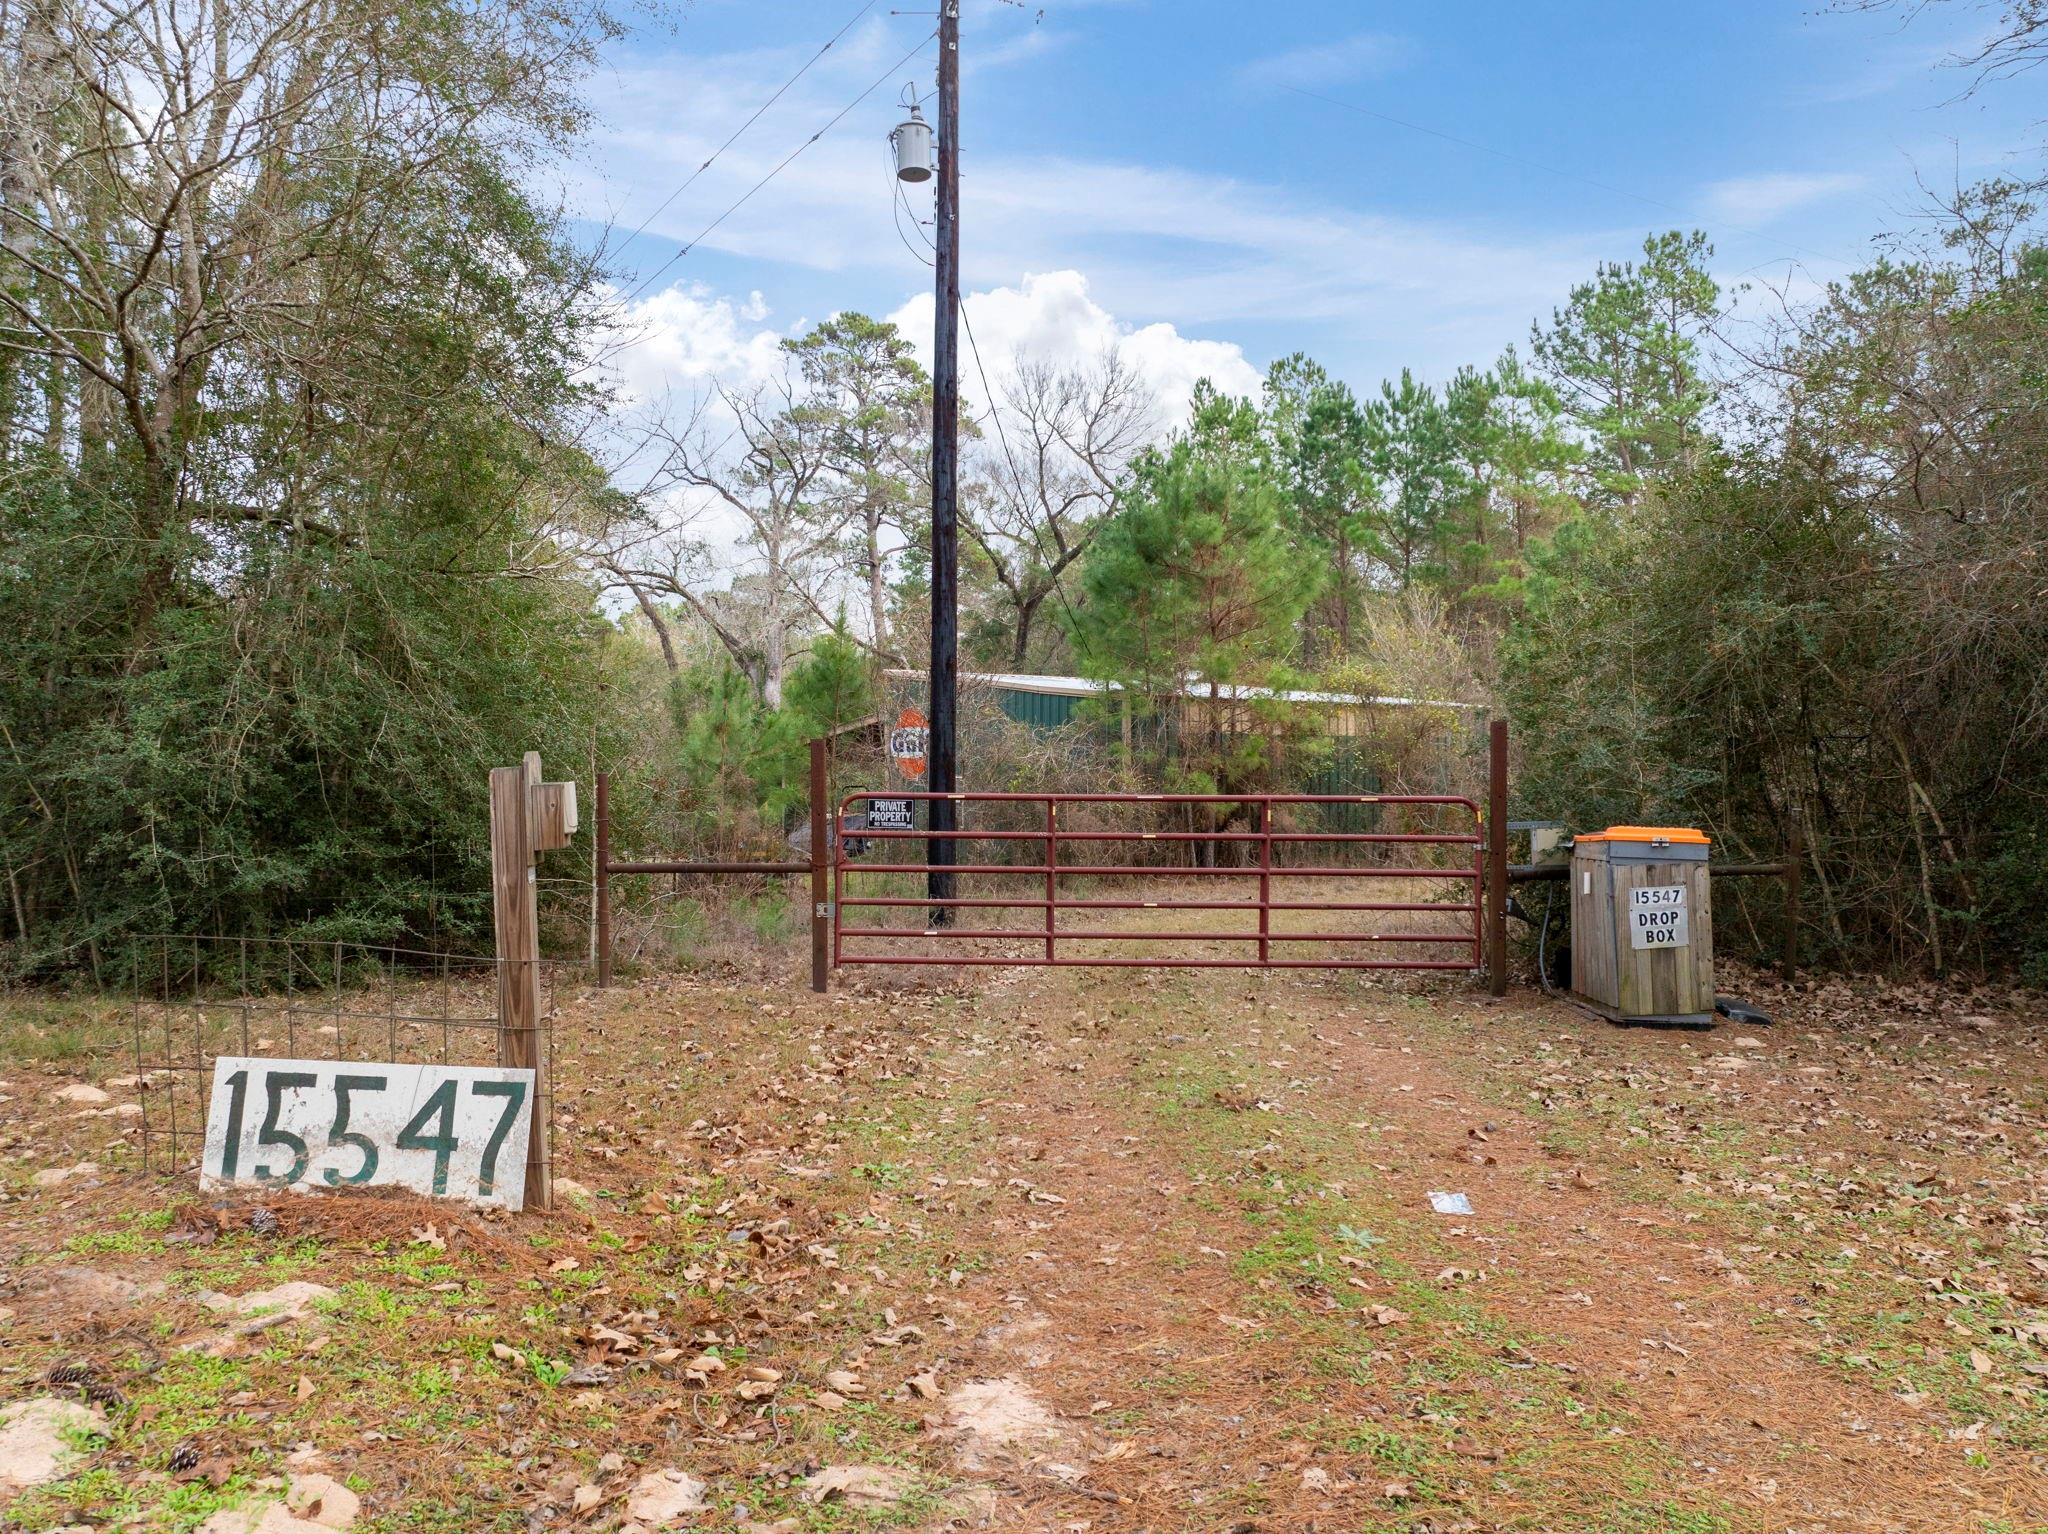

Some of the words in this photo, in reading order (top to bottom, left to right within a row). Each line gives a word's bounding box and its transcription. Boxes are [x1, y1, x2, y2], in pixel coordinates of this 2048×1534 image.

[874, 801, 907, 812] PRIVATE
[869, 811, 912, 822] PROPERTY
[1635, 889, 1680, 904] 15547
[1638, 911, 1679, 926] DROP
[1645, 929, 1675, 943] BOX
[221, 1071, 527, 1196] 15547
